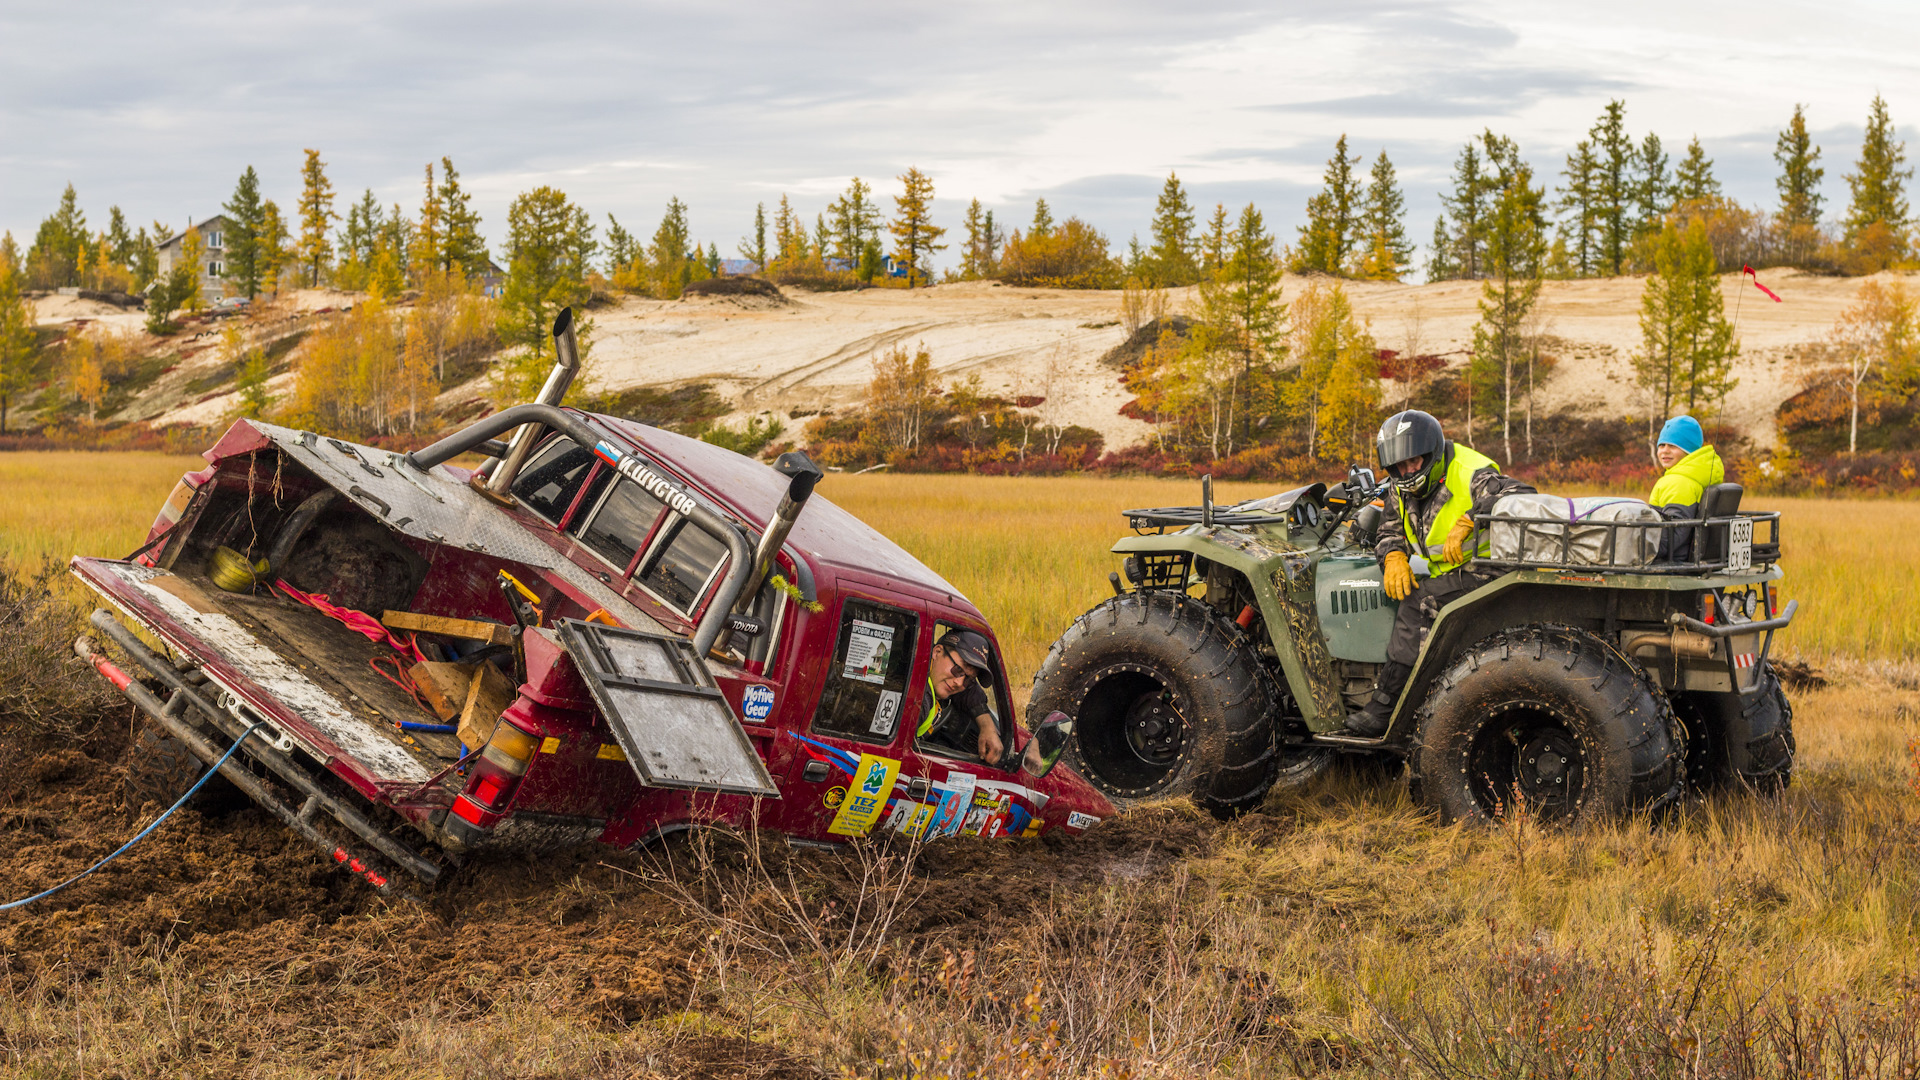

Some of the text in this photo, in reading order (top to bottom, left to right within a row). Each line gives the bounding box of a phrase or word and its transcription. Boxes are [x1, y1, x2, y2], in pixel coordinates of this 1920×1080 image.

[618, 456, 696, 515] И.ШУСТОВ
[1733, 523, 1750, 543] 6383
[1742, 551, 1750, 566] 89
[732, 620, 758, 633] TOYOTA
[745, 686, 775, 703] Motive
[745, 701, 769, 717] Gear
[854, 795, 878, 808] TEZ
[940, 793, 962, 830] 9
